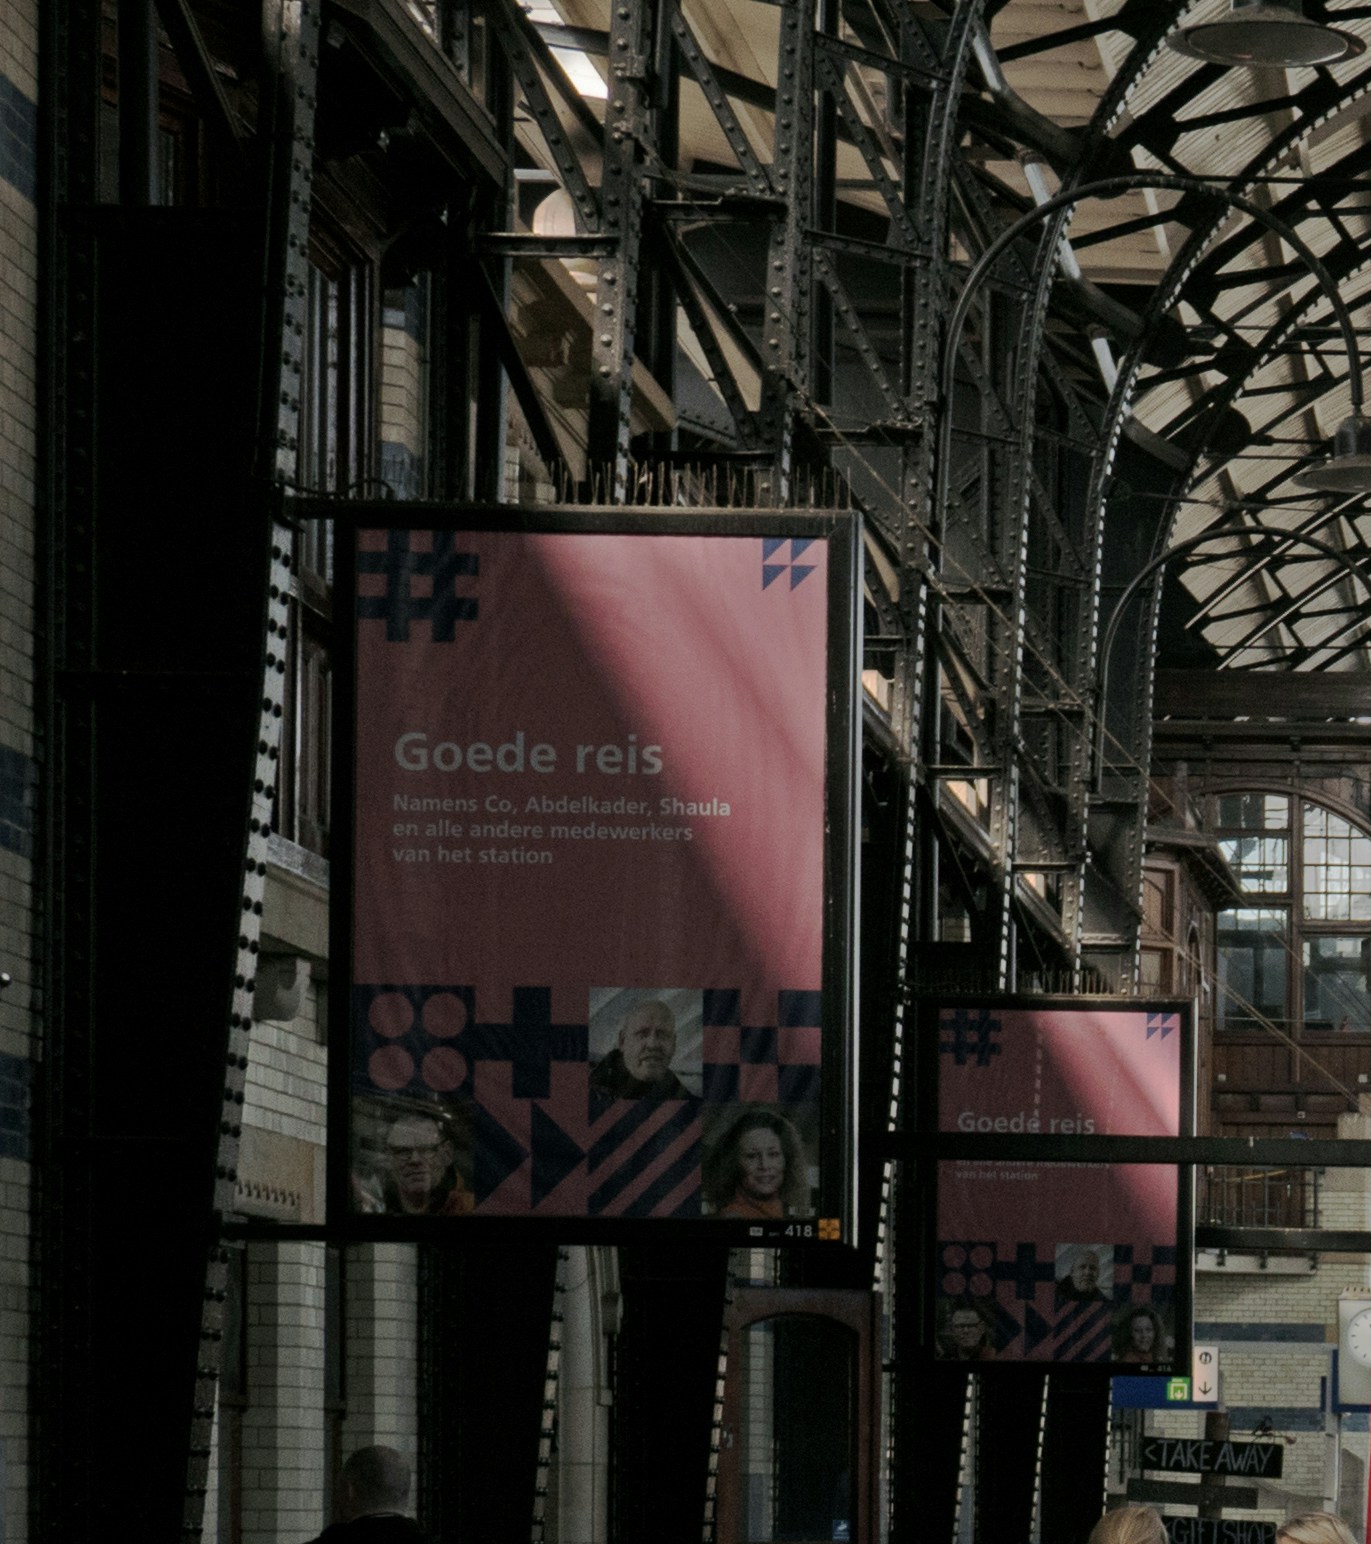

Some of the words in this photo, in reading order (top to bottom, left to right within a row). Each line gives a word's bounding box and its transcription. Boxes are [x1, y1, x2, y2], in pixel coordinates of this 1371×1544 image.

[395, 731, 557, 773] Goede
[576, 733, 663, 775] reis
[393, 794, 478, 812] Namens
[485, 795, 517, 815] Co,
[525, 795, 652, 817] Abdelkader,
[660, 797, 731, 816] Shaula
[393, 823, 418, 837] en
[425, 819, 463, 837] alle
[470, 820, 543, 839] andere
[551, 822, 693, 841] medewerkers
[392, 848, 430, 863] van
[438, 845, 472, 863] het
[478, 846, 552, 864] station
[957, 1111, 1041, 1133] Goede
[1050, 1112, 1095, 1135] reis
[784, 1225, 813, 1238] 418
[1156, 1440, 1214, 1471] TAKE
[1214, 1441, 1275, 1474] AWAY
